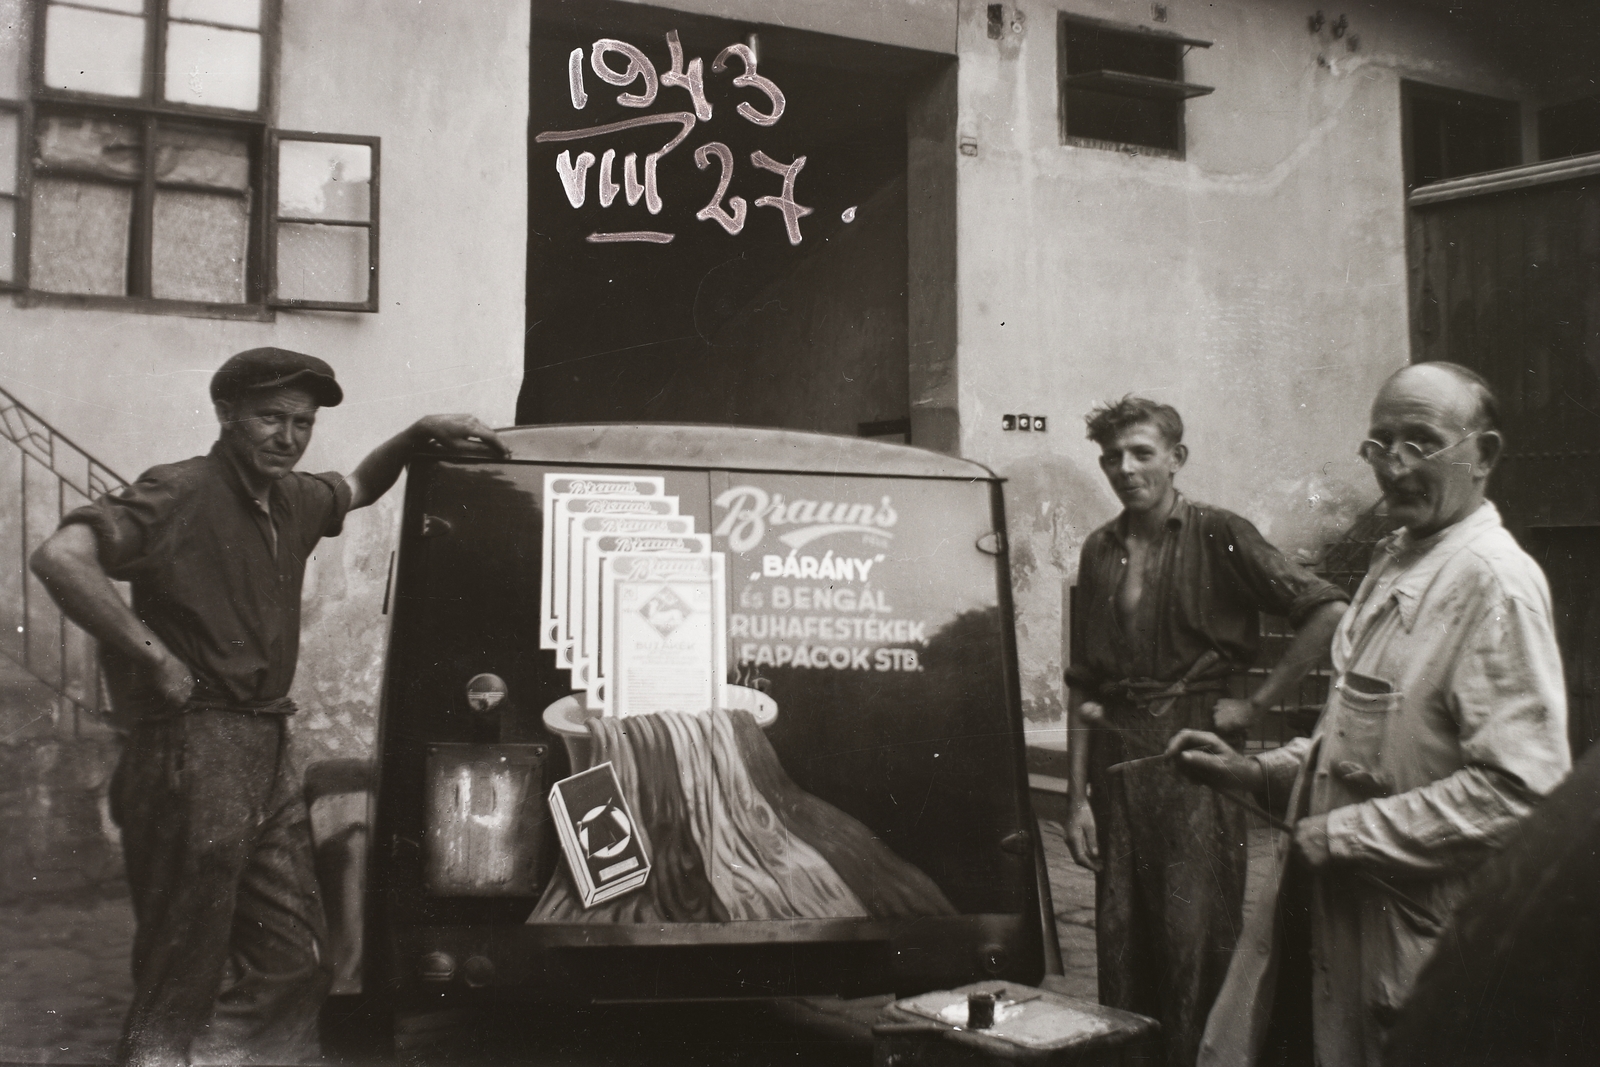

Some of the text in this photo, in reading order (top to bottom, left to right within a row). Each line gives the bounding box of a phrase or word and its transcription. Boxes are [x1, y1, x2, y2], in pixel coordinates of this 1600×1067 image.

[715, 485, 898, 552] Brauns
[772, 583, 893, 614] BENGÁL
[740, 639, 925, 672] FAPÁCOK STB.
